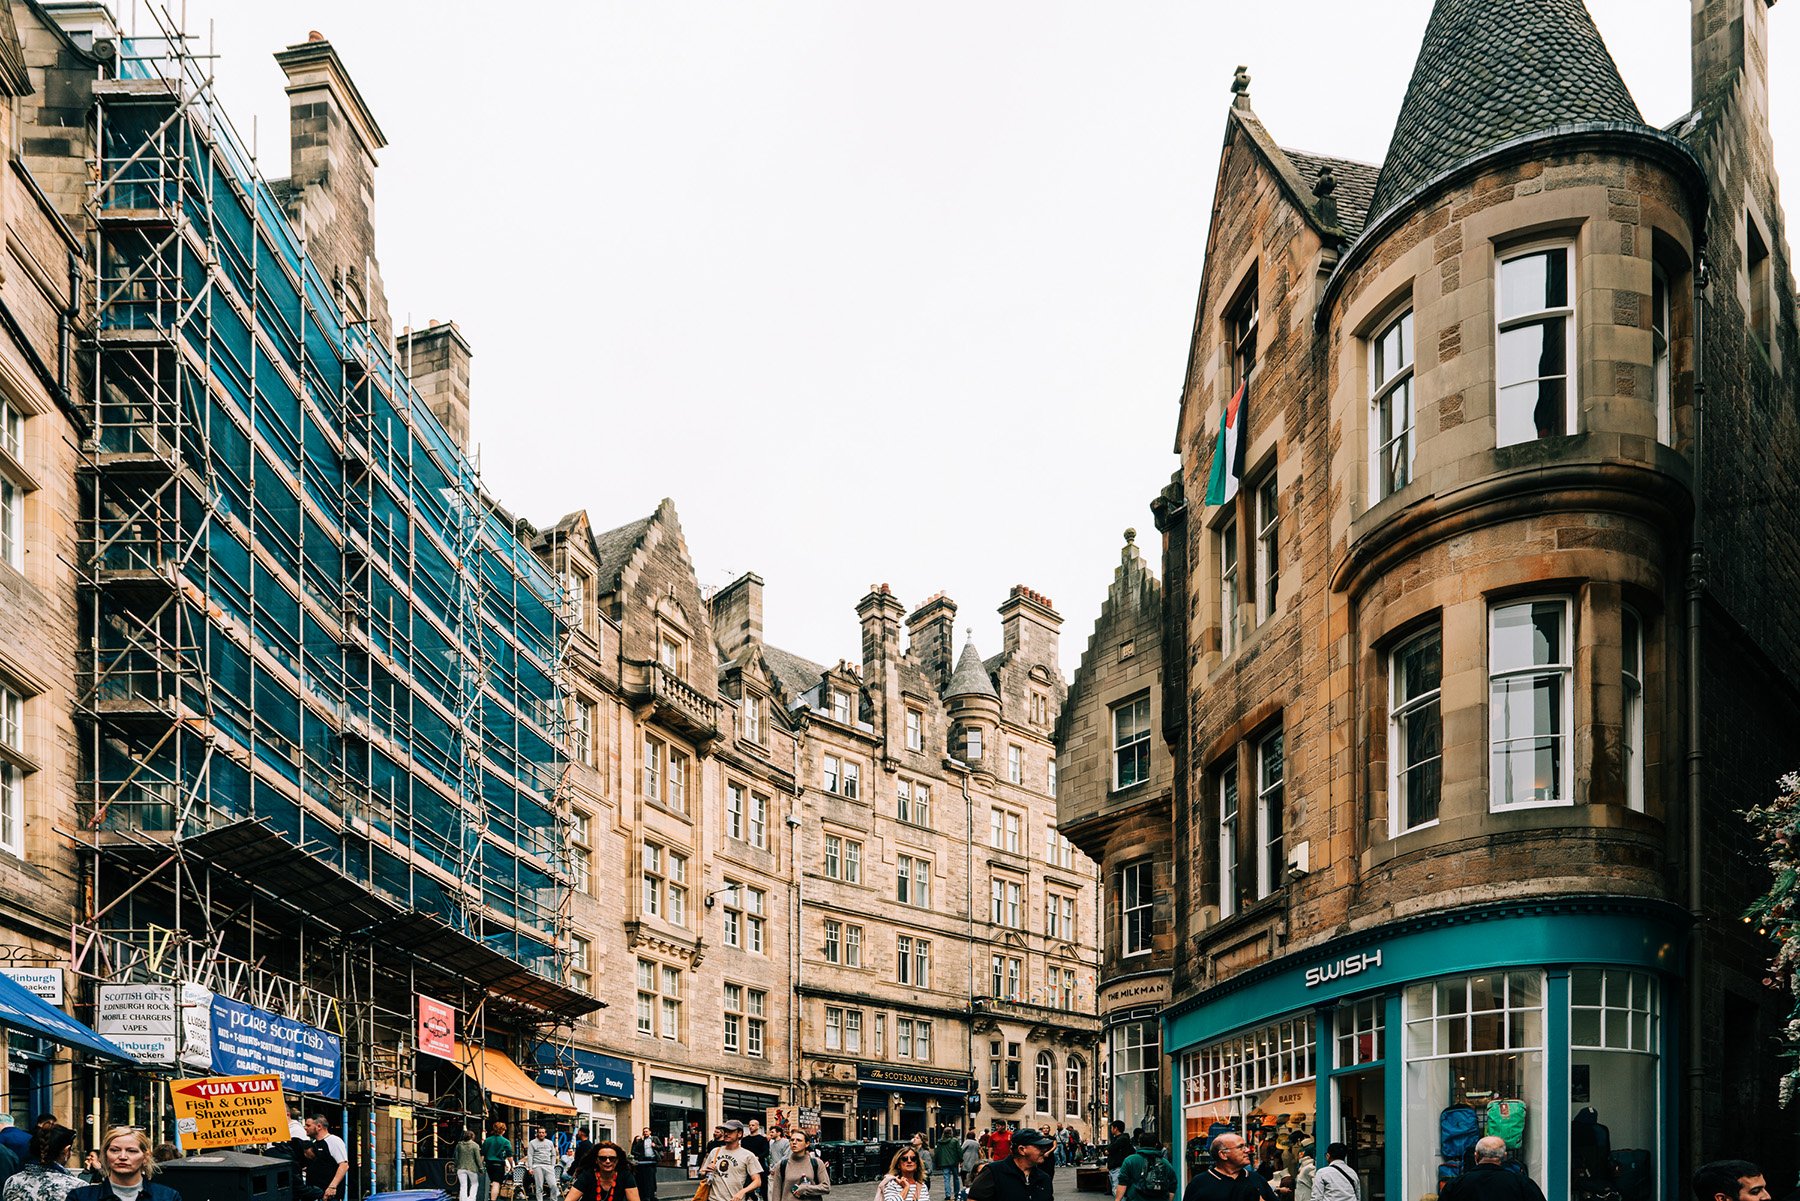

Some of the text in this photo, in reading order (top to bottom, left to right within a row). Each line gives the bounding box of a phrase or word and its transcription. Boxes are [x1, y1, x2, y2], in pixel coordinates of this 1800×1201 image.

[1305, 949, 1382, 987] SWISH
[105, 992, 170, 1001] SCOTTISH GIFTS
[1108, 985, 1164, 1001] THE MILKMAN
[147, 1003, 170, 1011] ROCK
[113, 1042, 165, 1051] dinburgh
[606, 1077, 624, 1090] Beauty
[870, 1070, 958, 1087] The SCOTSMAN'S LOUNGE
[196, 1080, 276, 1096] YUM YUM
[185, 1096, 273, 1110] Fish & Chips
[1279, 1094, 1302, 1103] BARTS
[195, 1107, 267, 1120] Shawerma
[212, 1117, 255, 1128] Pizzas
[193, 1126, 277, 1140] Falafel Wrap
